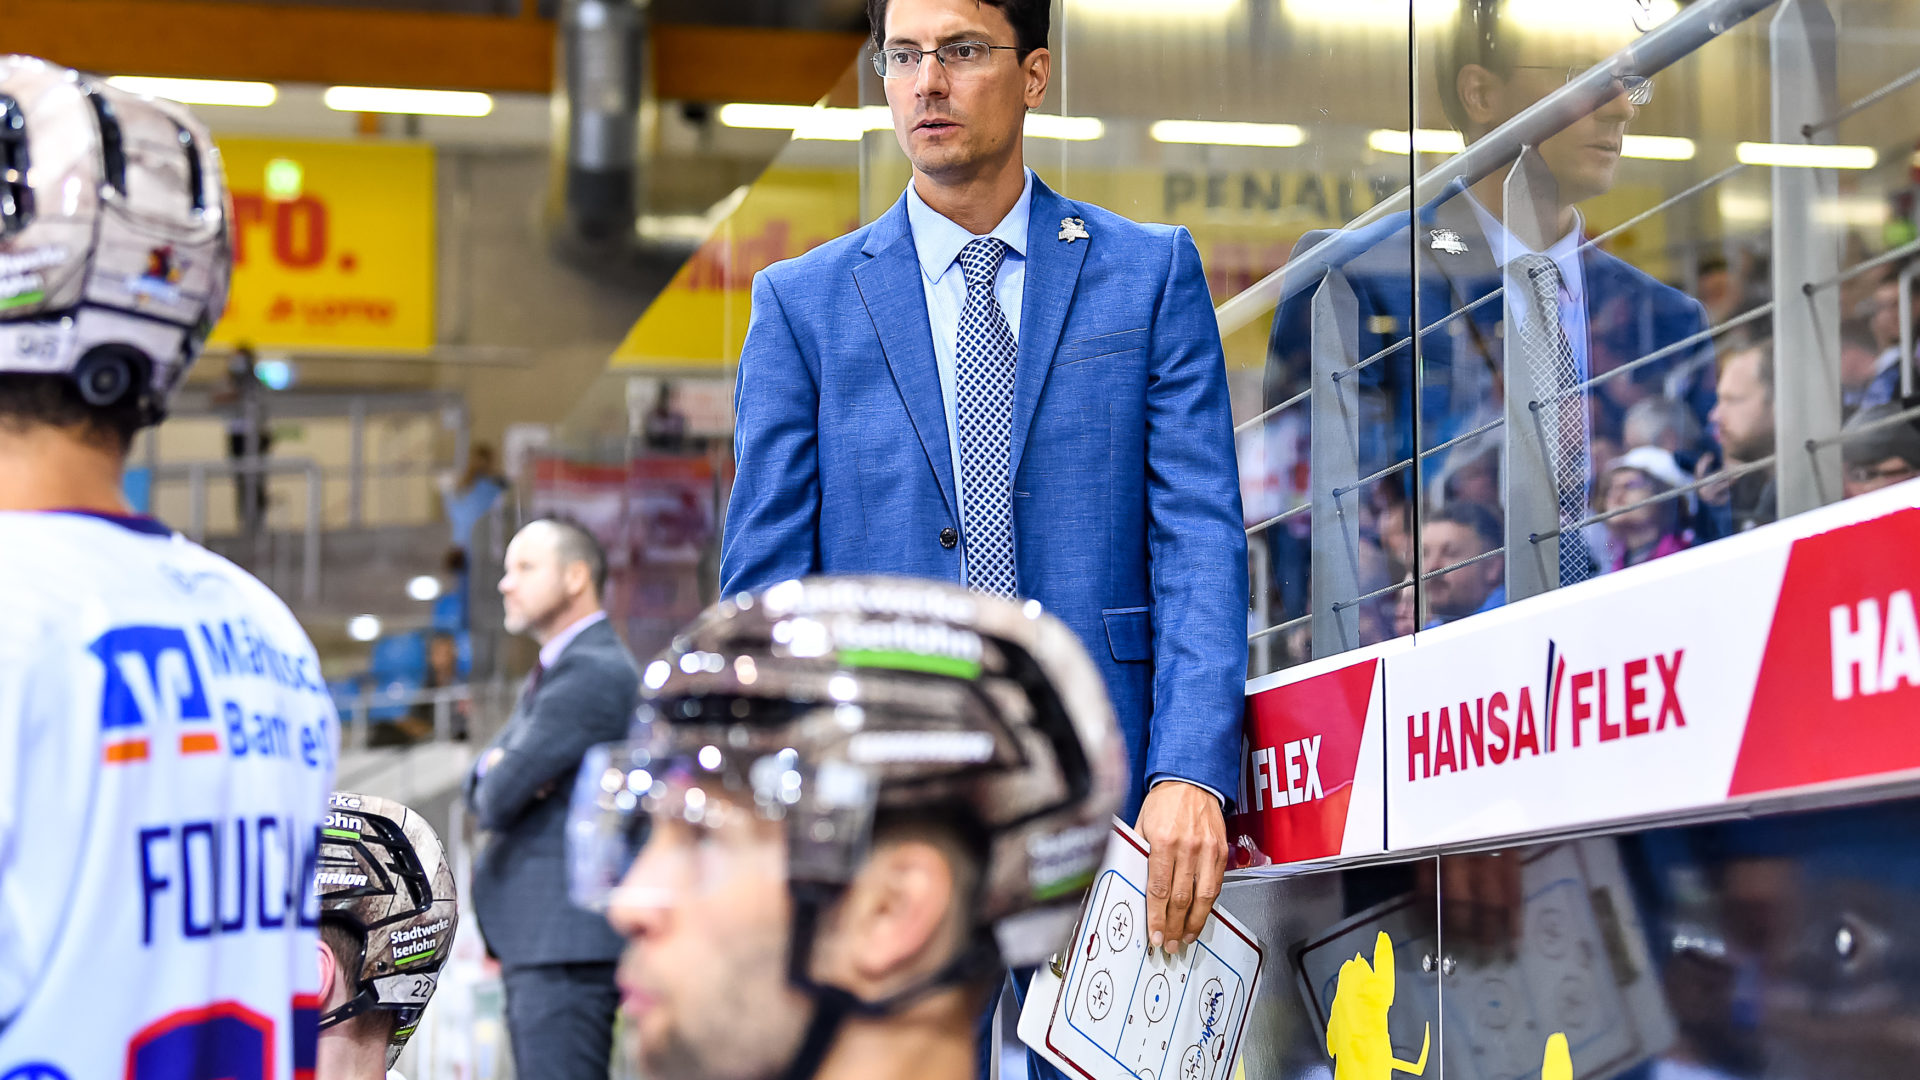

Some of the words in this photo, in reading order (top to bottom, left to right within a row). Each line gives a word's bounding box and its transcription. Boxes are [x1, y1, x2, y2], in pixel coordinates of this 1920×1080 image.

[1407, 686, 1539, 782] HANSA
[1571, 649, 1686, 748] FLEX
[1251, 734, 1324, 812] FLEX
[391, 918, 449, 945] Stadtwerke
[393, 938, 436, 959] Iserlohn
[411, 979, 431, 998] 22
